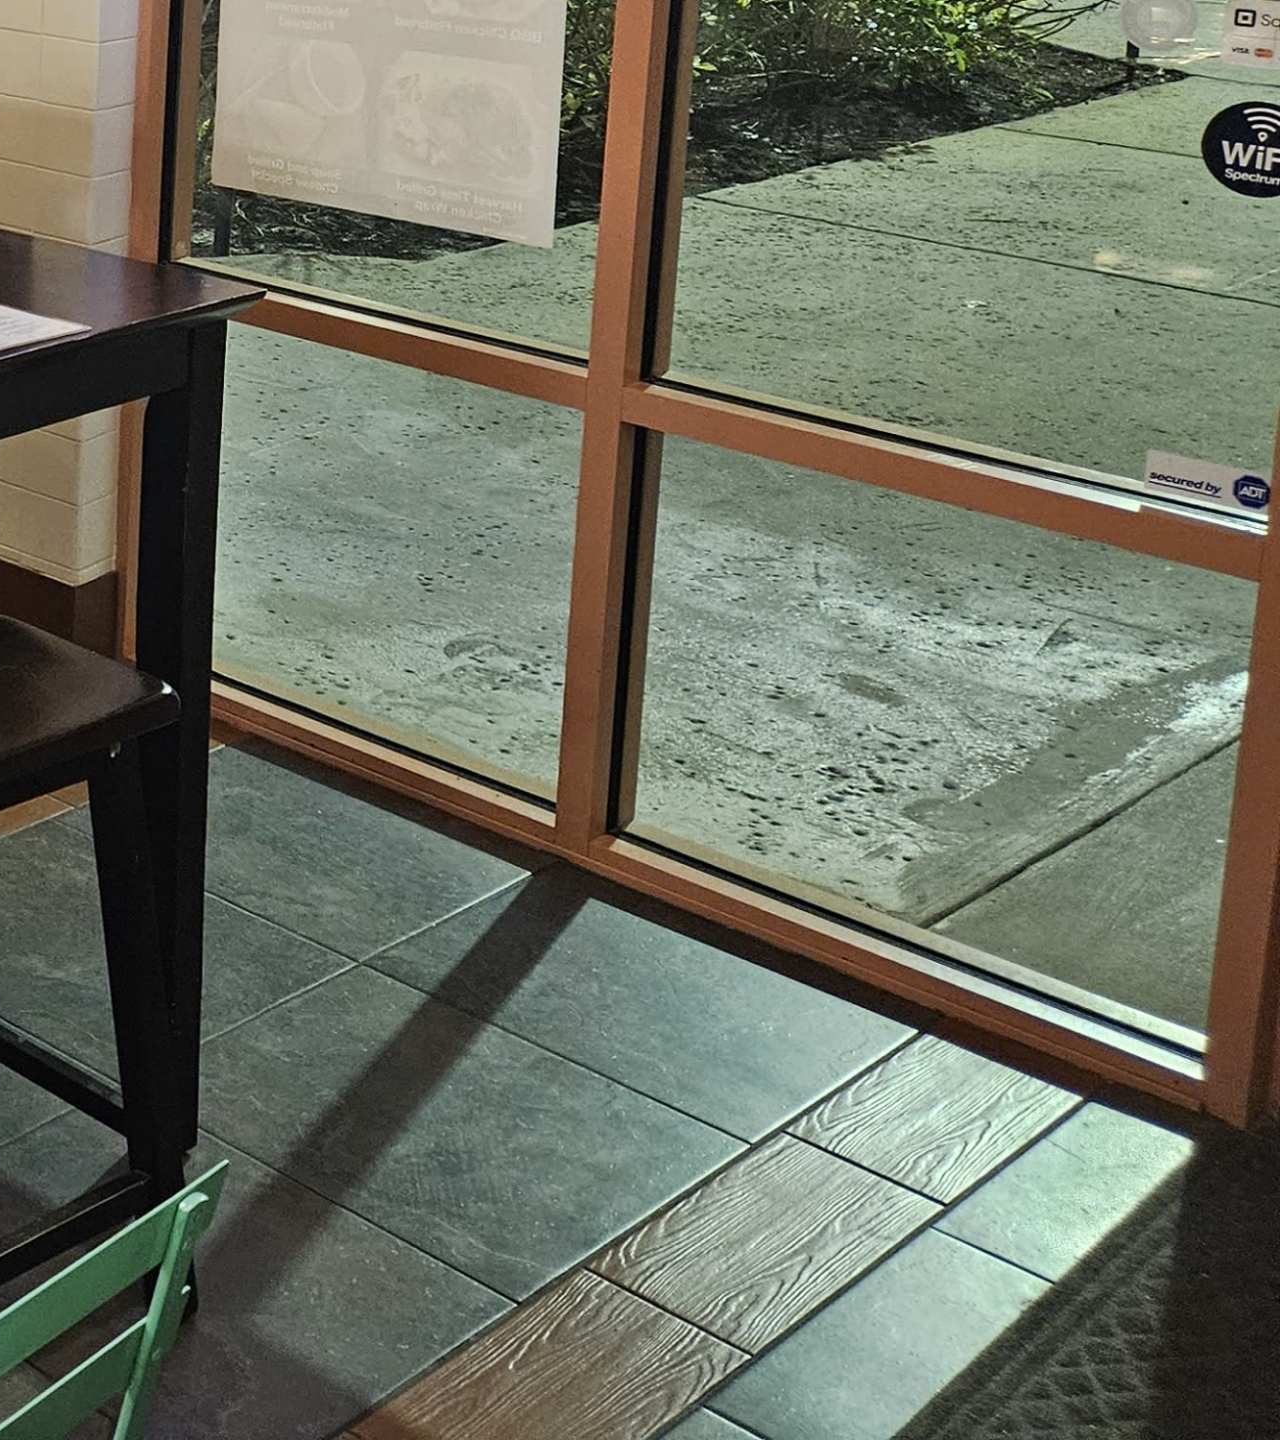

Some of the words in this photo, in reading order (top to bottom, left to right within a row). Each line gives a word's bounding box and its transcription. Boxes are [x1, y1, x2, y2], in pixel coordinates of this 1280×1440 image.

[1150, 472, 1204, 490] secured
[1205, 482, 1223, 495] by
[1238, 485, 1268, 500] ADT
